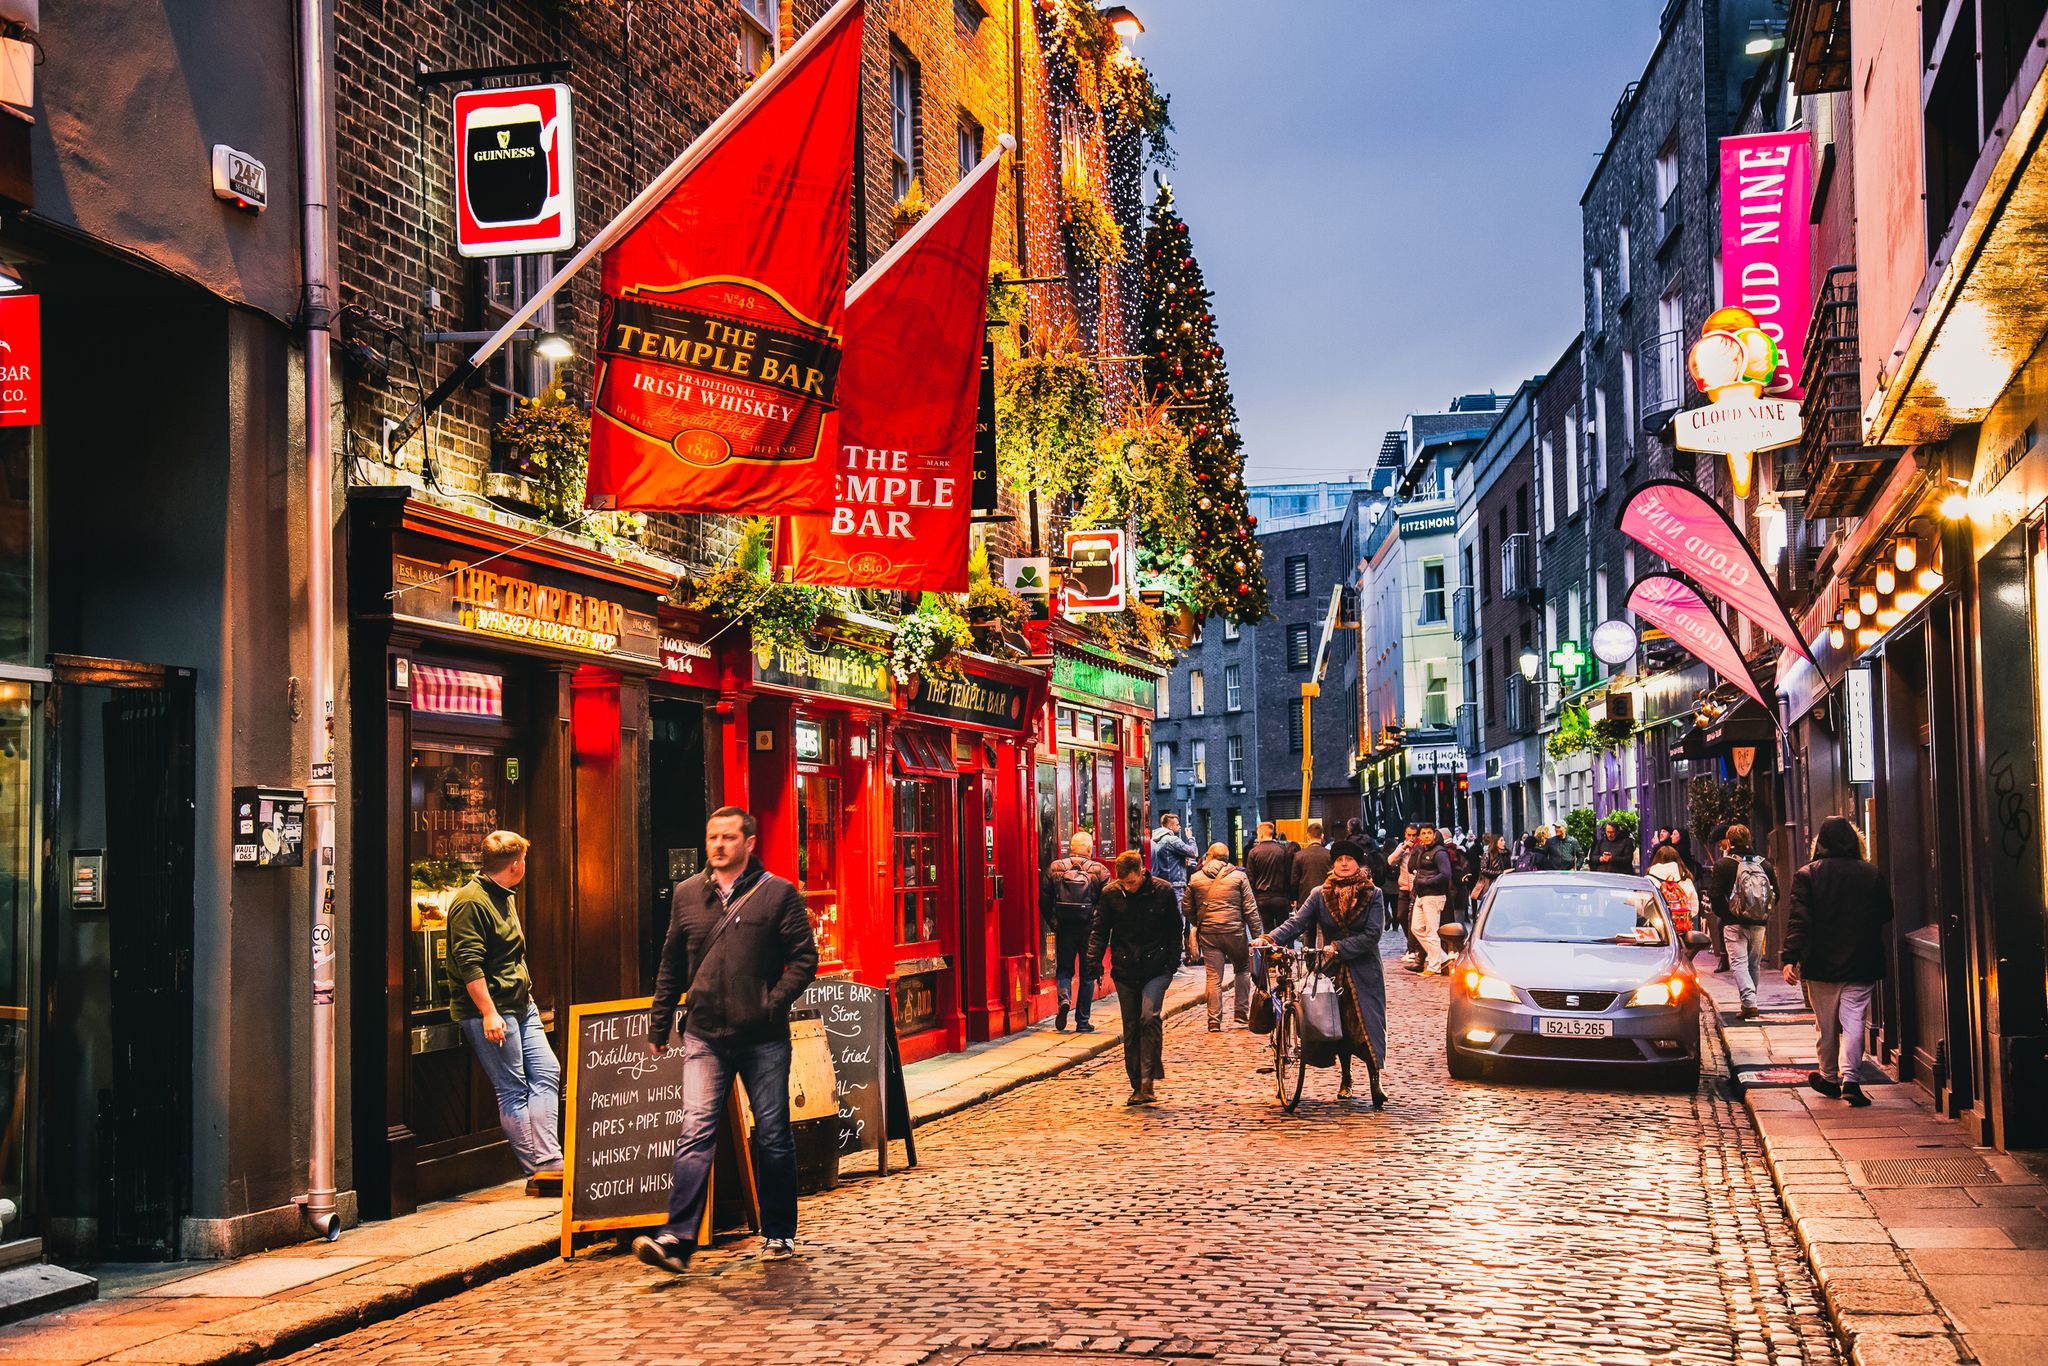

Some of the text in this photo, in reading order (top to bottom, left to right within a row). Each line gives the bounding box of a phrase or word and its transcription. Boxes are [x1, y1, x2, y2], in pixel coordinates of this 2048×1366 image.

[474, 146, 535, 162] GUINNESS
[1739, 145, 1791, 247] NINE
[704, 320, 757, 350] THE
[617, 323, 825, 397] TEMPLE BAR
[3, 389, 27, 402] CO.
[633, 373, 794, 423] IRISH WHISKEY
[677, 372, 756, 398] TRADITIONAL
[616, 404, 653, 429] DUBLIN
[717, 413, 765, 440] Blend
[1692, 403, 1785, 430] CLOUD NINE
[687, 443, 718, 460] 1840
[843, 445, 908, 472] THE
[926, 459, 950, 467] MARK
[830, 506, 915, 539] BAR
[1401, 516, 1456, 532] FITZSIMONS
[399, 563, 416, 579] Est.
[857, 561, 883, 574] 1840
[450, 559, 626, 636] THE TEMPLE BAR
[542, 619, 589, 645] TOBACCO
[590, 632, 617, 652] SHOP
[805, 652, 849, 685] TEMPLE
[926, 679, 1006, 715] THE TEMPLE BAR
[1417, 751, 1464, 761] FITZIMONS
[804, 984, 845, 1005] TEMPLE
[828, 1004, 861, 1023] Store
[1546, 1021, 1605, 1035] 152-LS-265
[586, 1043, 649, 1078] Distillery
[841, 1044, 871, 1065] tried
[591, 1084, 682, 1111] PREMIUM WHISK
[592, 1117, 625, 1139] PIPES
[636, 1112, 660, 1131] PIPE
[592, 1144, 641, 1168] WHISKEY
[589, 1172, 674, 1201] SCOTCH WHISK
